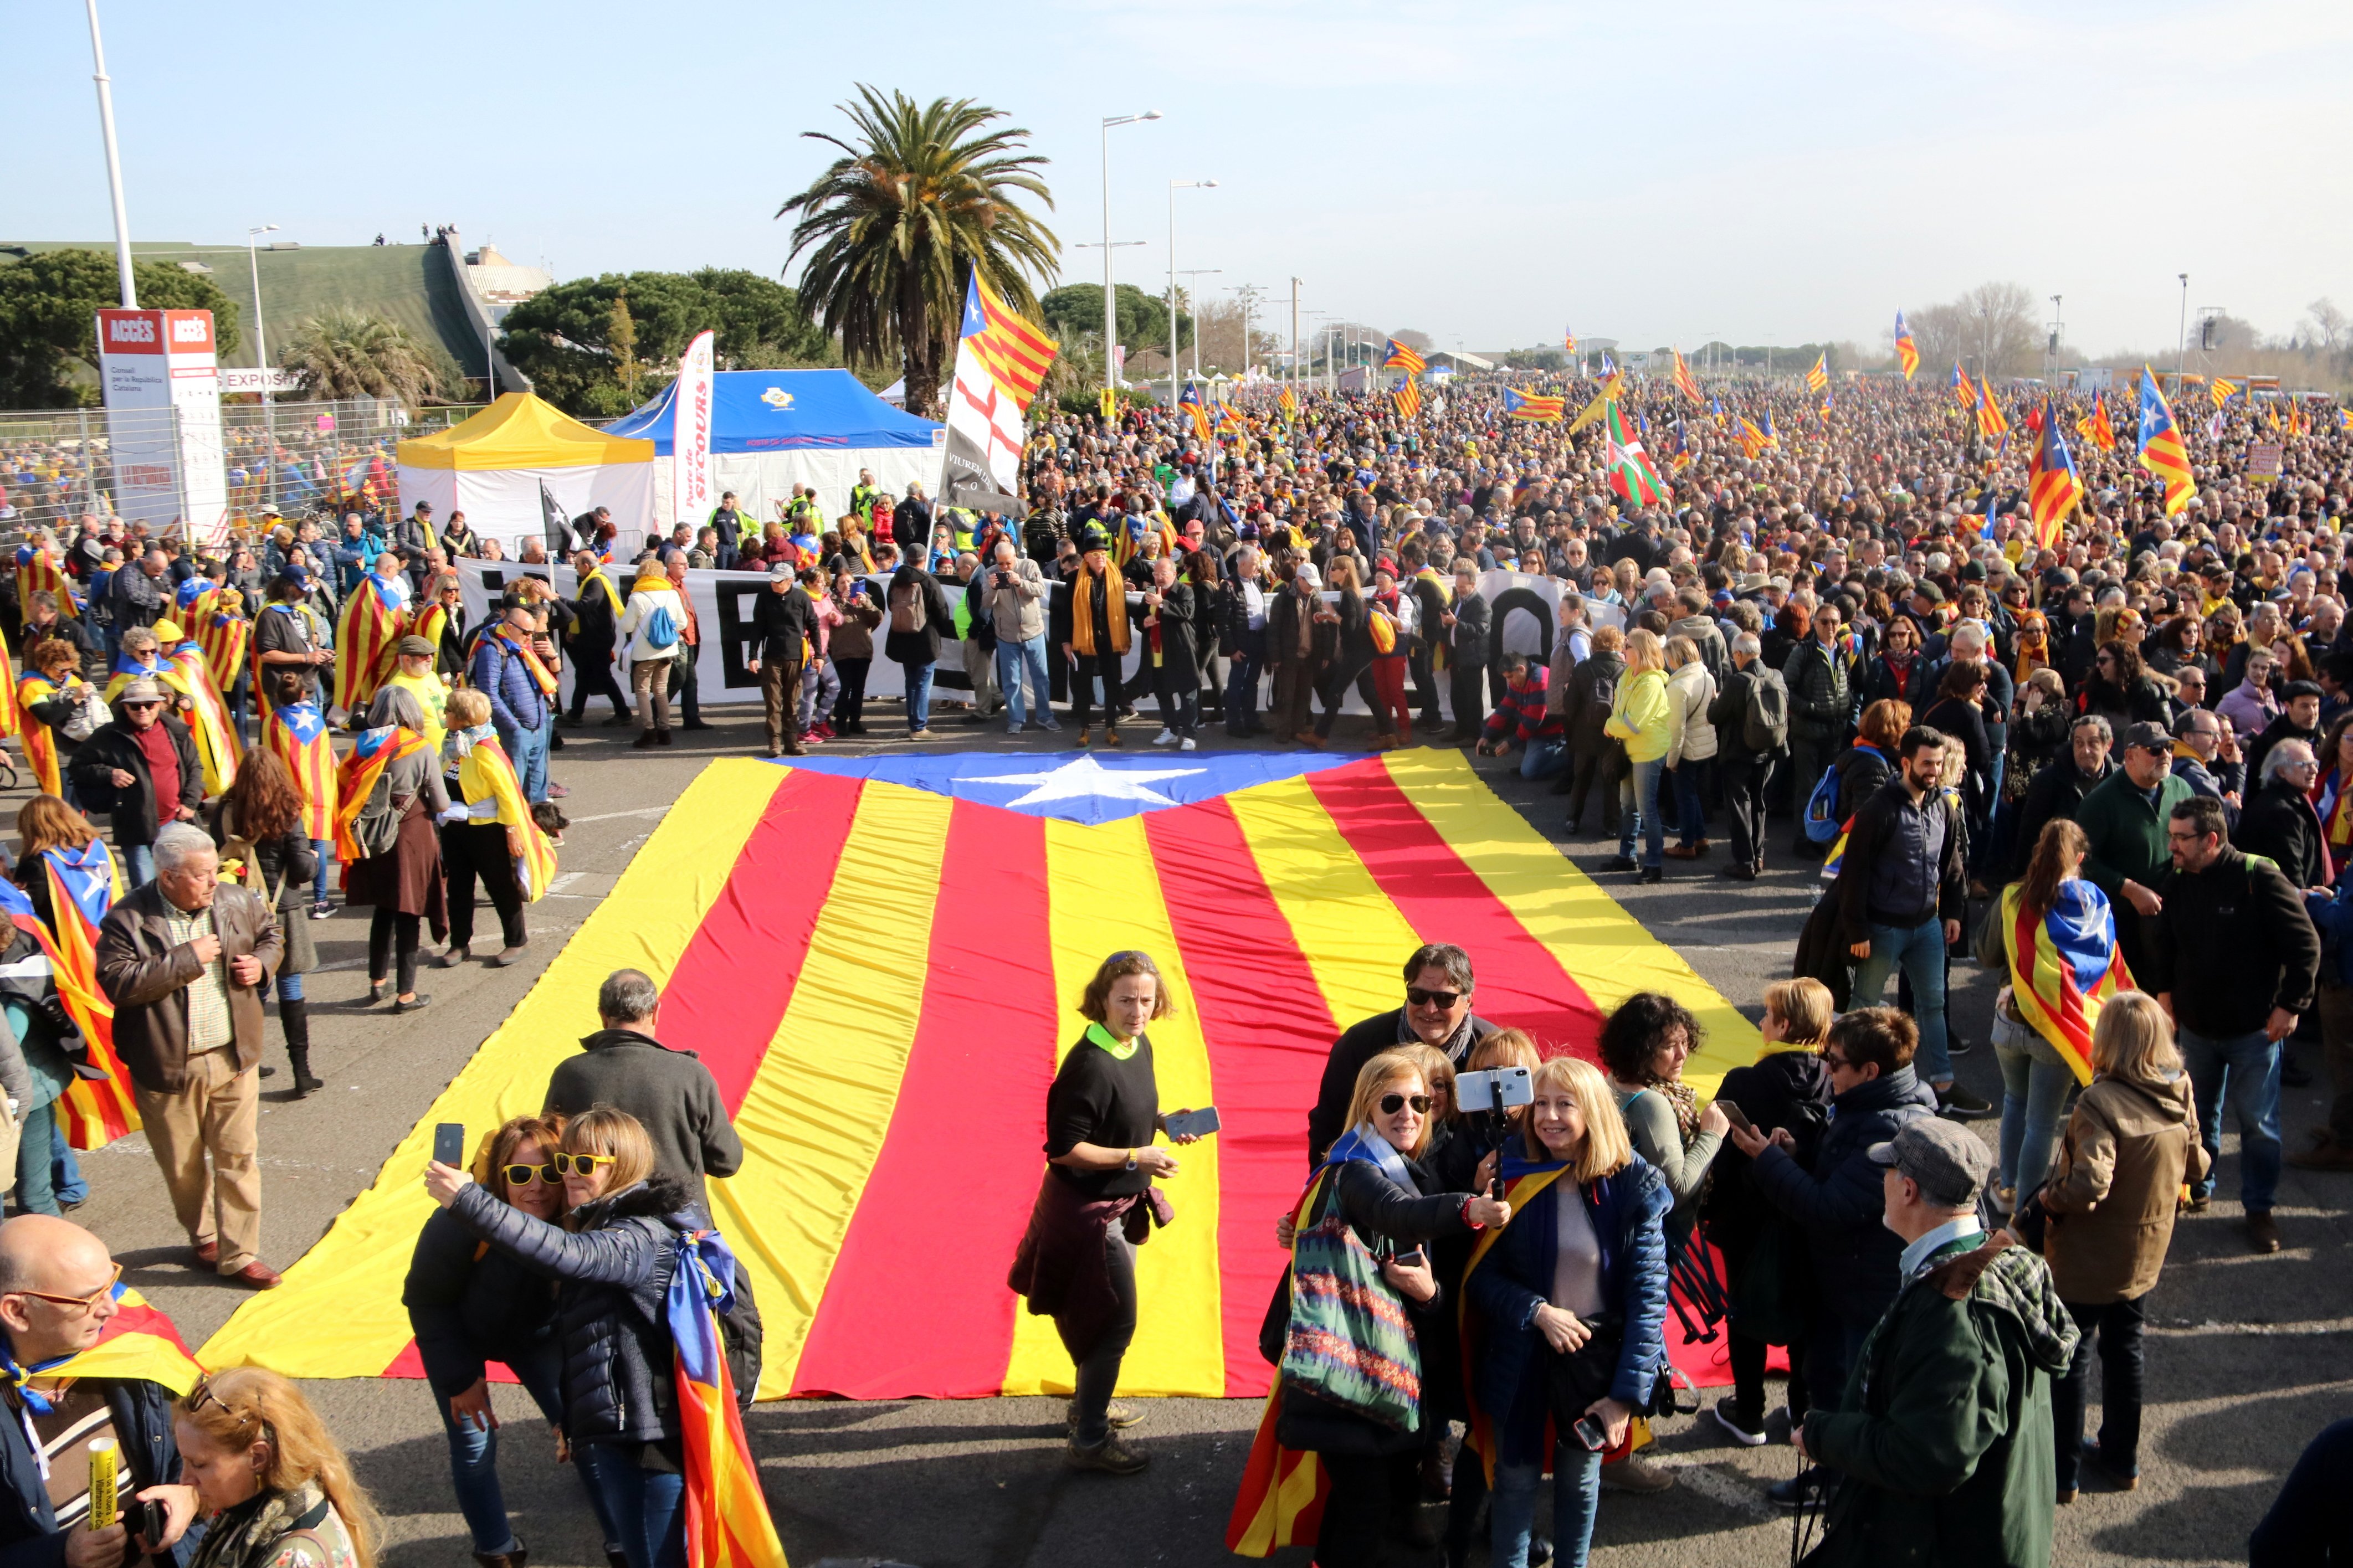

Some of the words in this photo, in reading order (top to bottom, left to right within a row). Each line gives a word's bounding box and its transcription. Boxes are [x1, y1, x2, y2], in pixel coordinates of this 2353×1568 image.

[111, 316, 155, 342] ACCÉS
[174, 316, 207, 342] ACCÉS
[228, 374, 298, 386] EXPOSIT
[695, 380, 706, 502] SECOURS
[686, 449, 693, 466] de
[949, 453, 983, 477] VIUREM
[686, 470, 694, 509] Poste
[970, 482, 977, 490] O
[95, 1479, 104, 1509] Vilafranca
[107, 1478, 112, 1487] de
[95, 1510, 101, 1518] de
